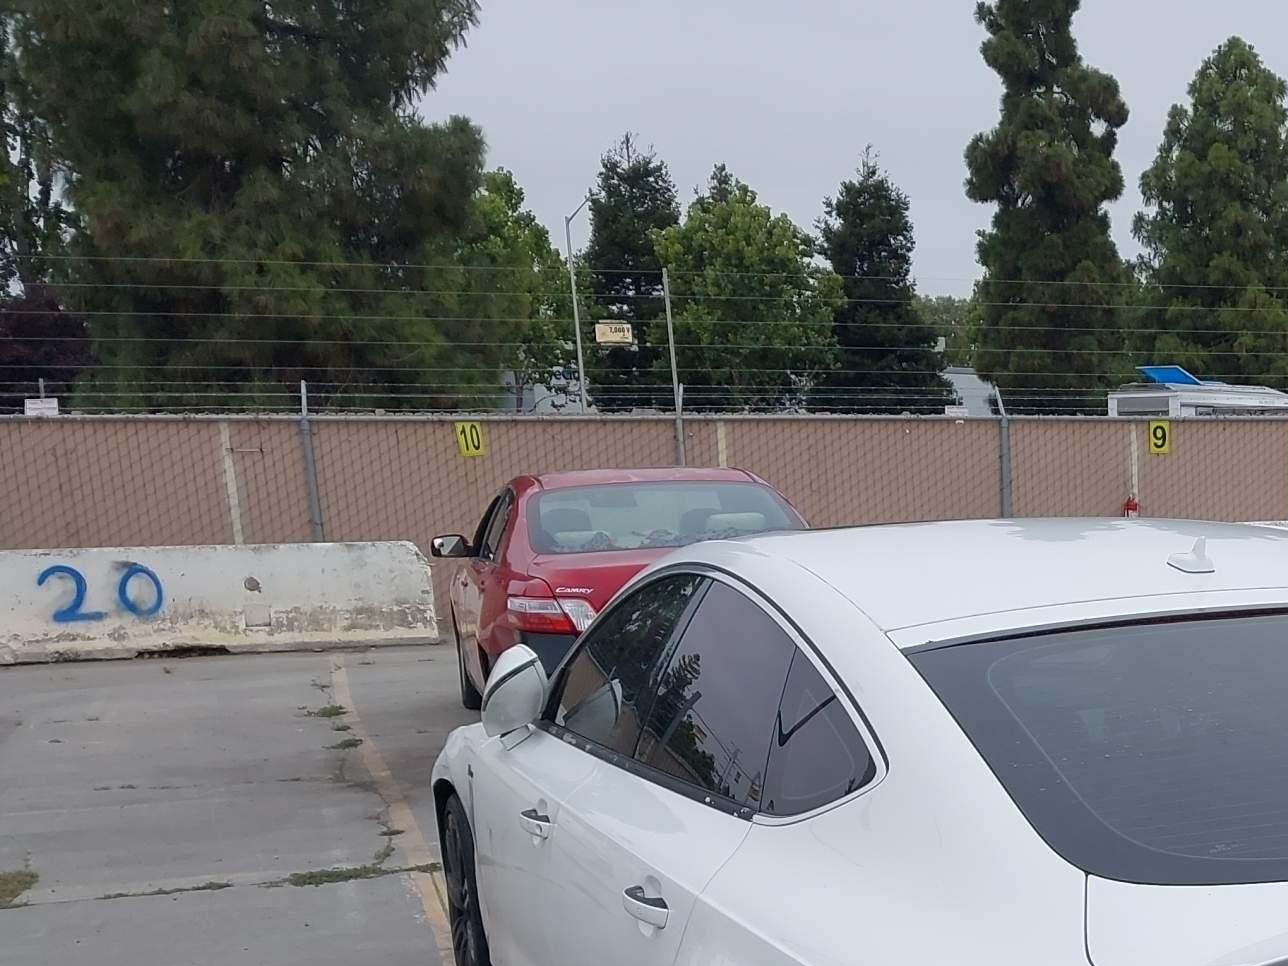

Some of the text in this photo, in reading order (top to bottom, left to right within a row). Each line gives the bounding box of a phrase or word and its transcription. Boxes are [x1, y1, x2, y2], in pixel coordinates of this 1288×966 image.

[460, 423, 480, 451] 10
[1152, 425, 1167, 449] 9
[37, 562, 163, 622] 20
[555, 586, 595, 594] CAMRY
